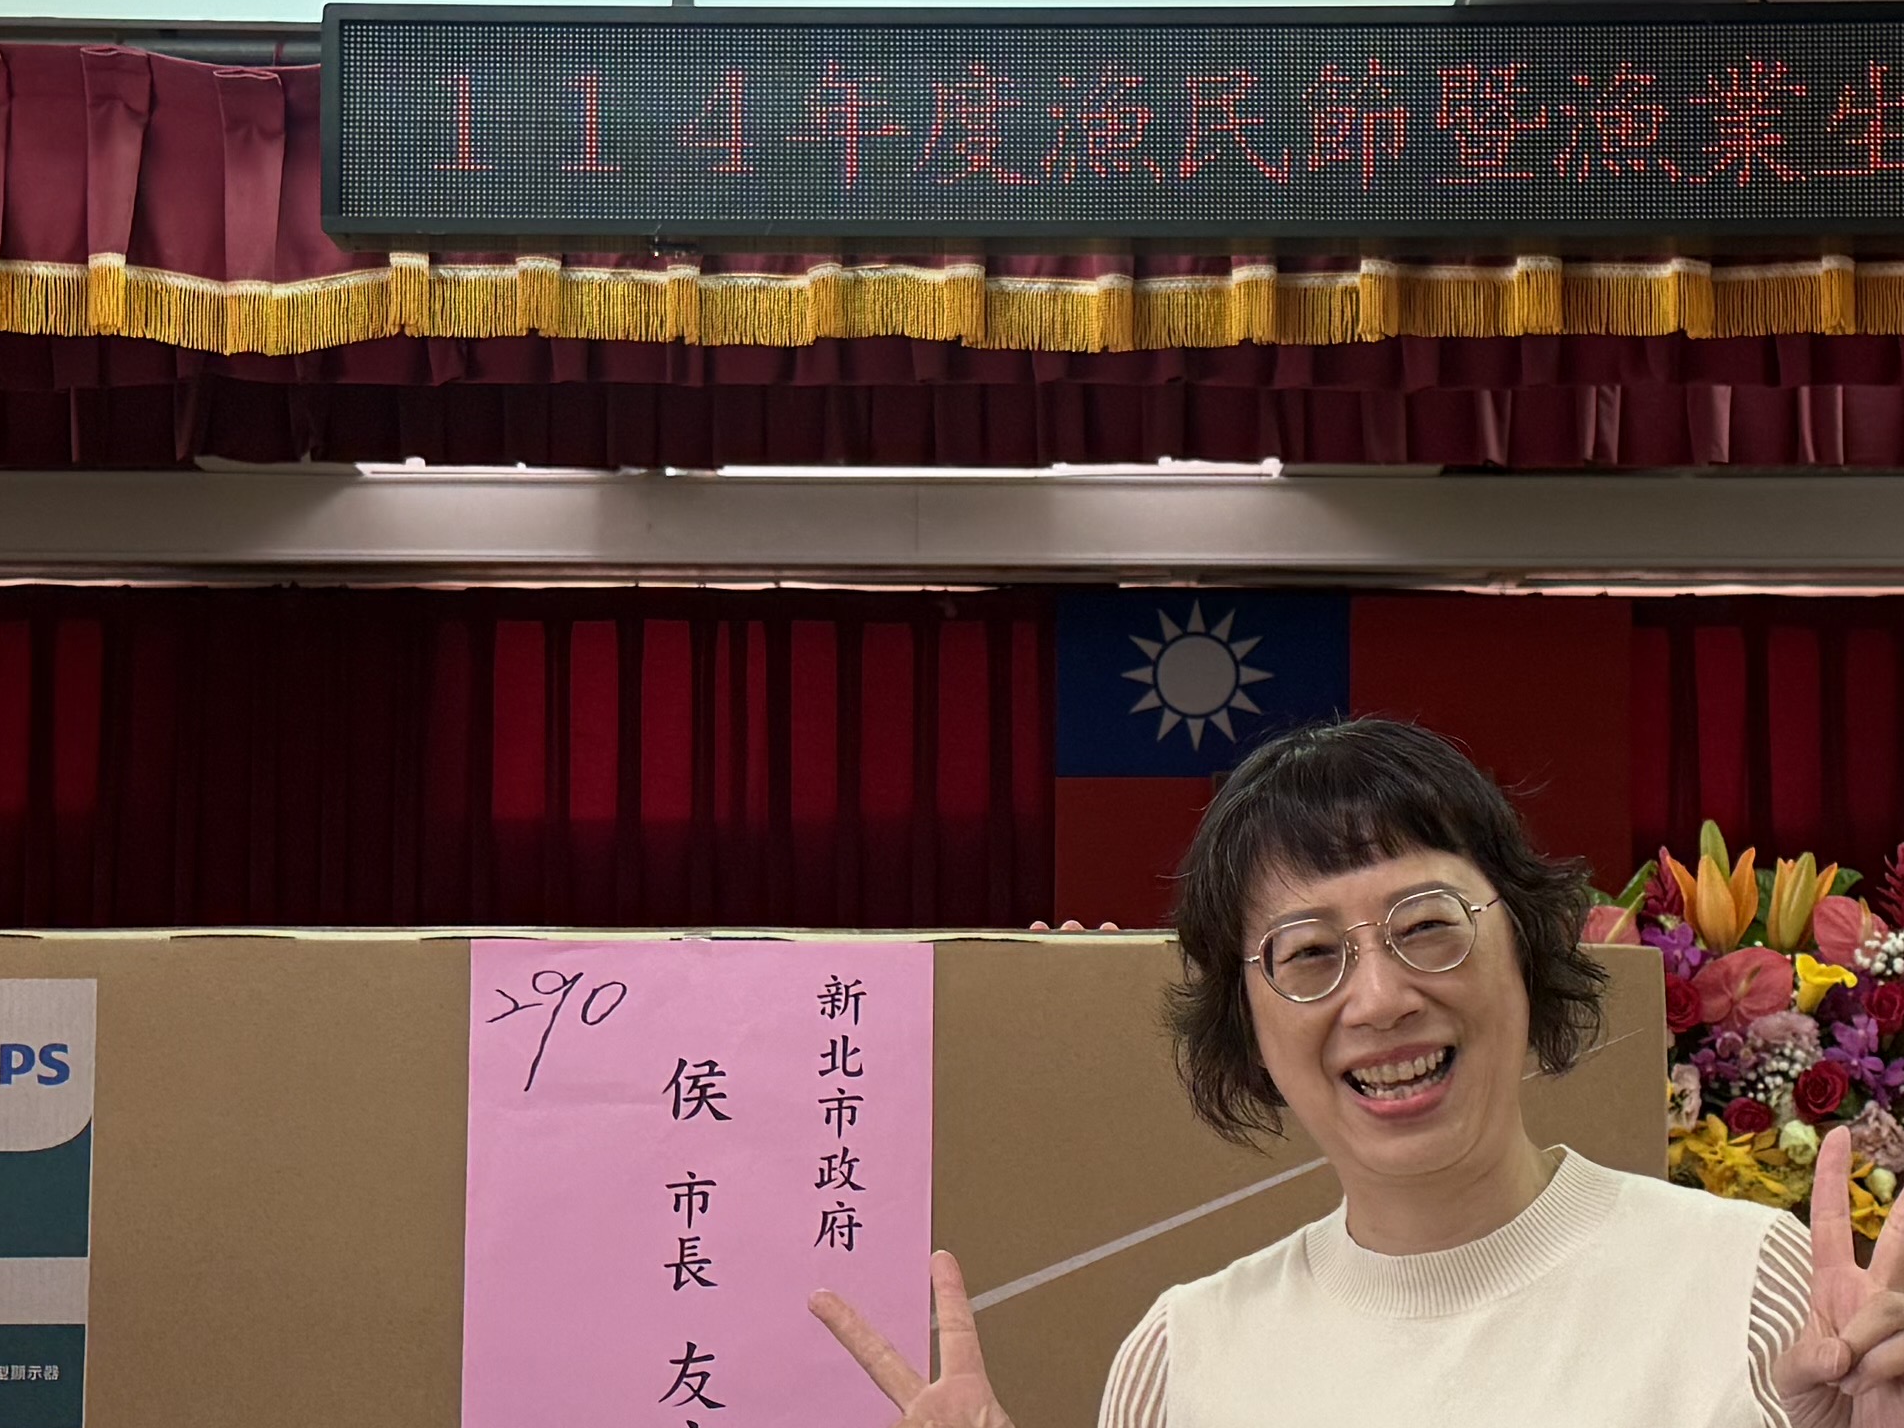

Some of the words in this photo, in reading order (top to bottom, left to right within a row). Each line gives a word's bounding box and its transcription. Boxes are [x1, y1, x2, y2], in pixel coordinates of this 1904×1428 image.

[813, 974, 867, 1253] 新北市政府
